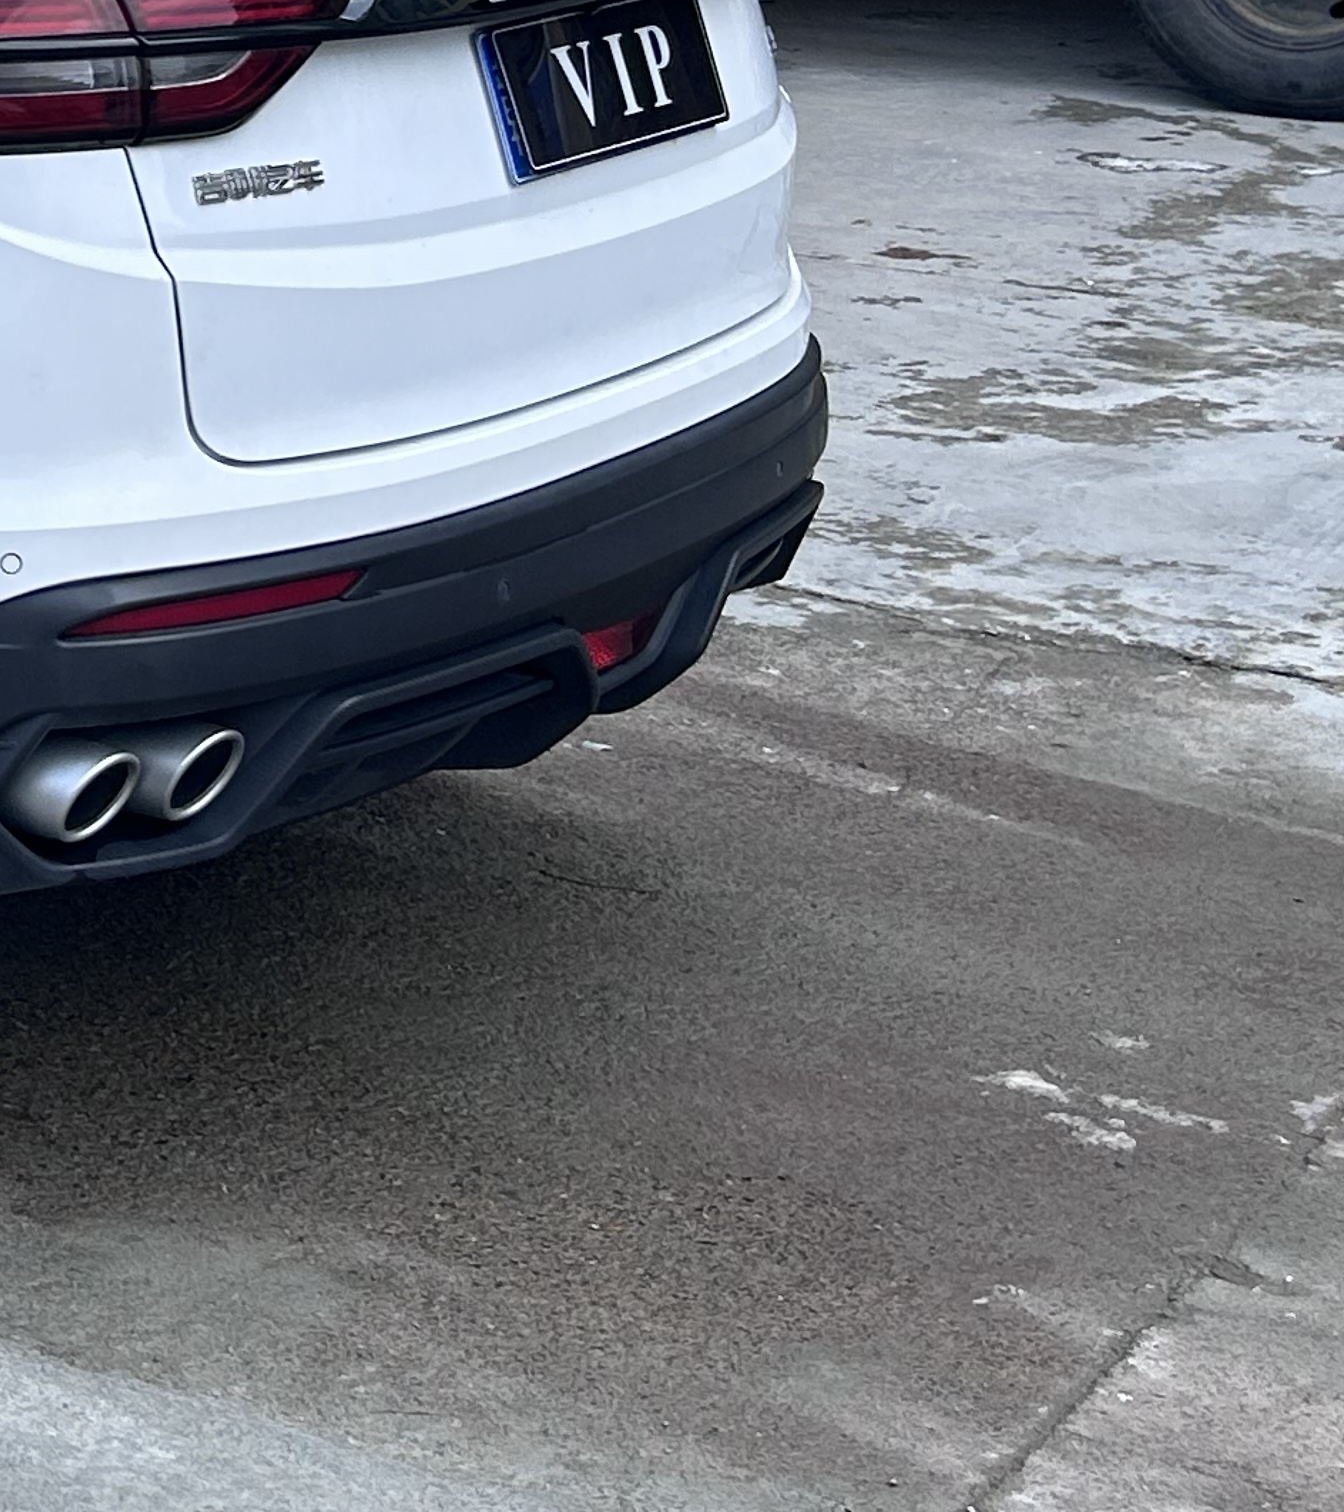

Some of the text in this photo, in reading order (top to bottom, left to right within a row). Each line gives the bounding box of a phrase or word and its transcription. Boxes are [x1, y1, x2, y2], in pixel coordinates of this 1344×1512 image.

[549, 24, 673, 128] VIP
[192, 160, 325, 206] 吉利汽车
